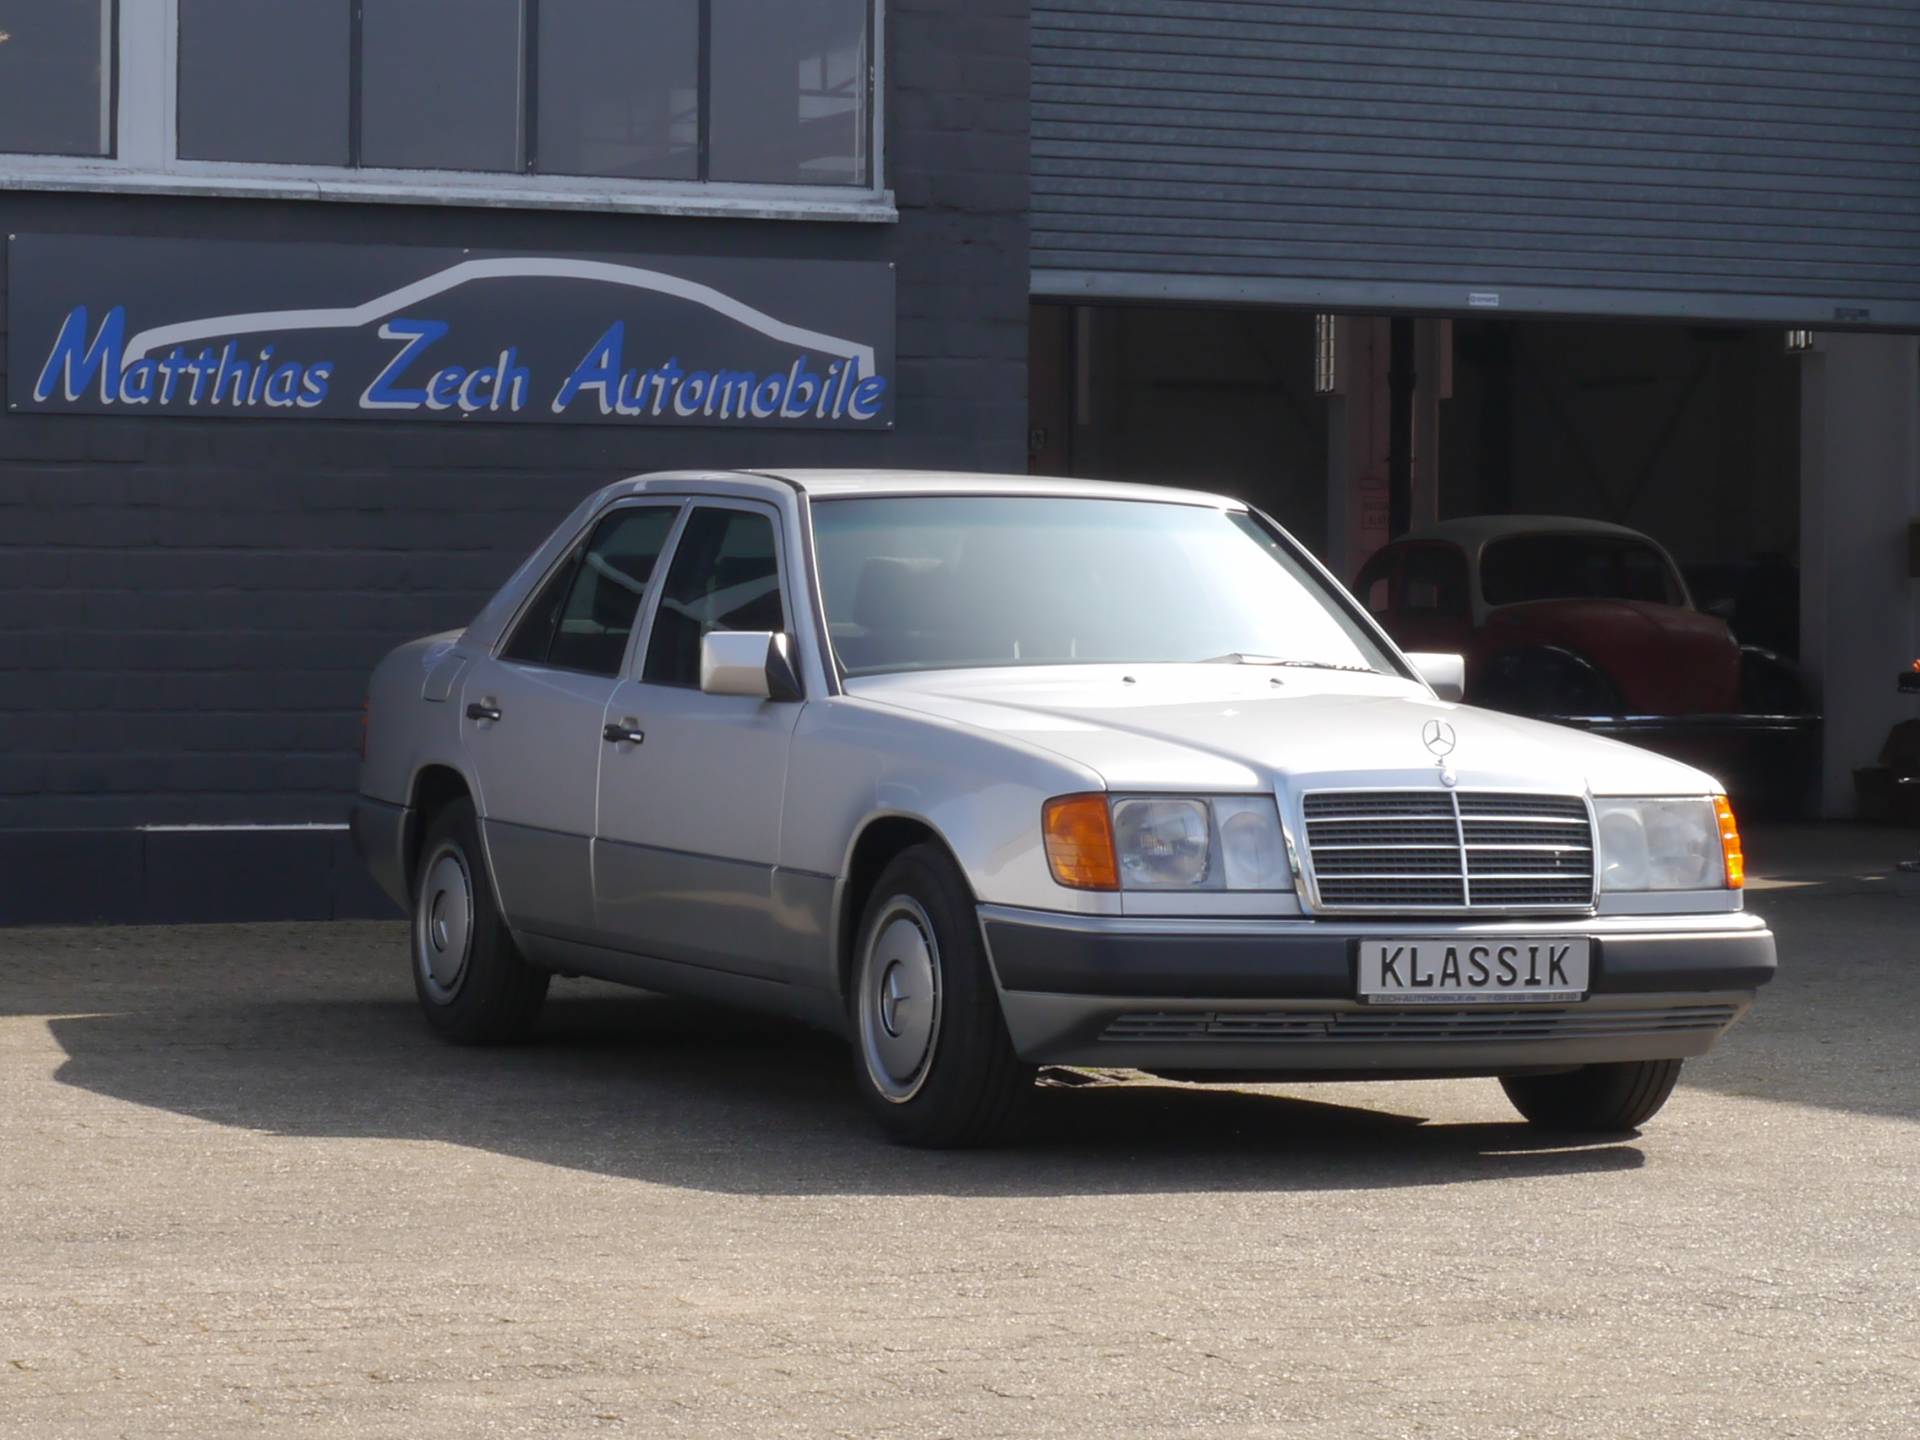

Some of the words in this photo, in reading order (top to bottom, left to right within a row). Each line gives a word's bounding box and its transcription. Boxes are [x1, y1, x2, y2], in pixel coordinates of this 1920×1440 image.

[33, 304, 335, 408] Matthias
[359, 318, 530, 412] Zech
[551, 319, 888, 420] Automobile
[1380, 945, 1571, 988] KLASSIK
